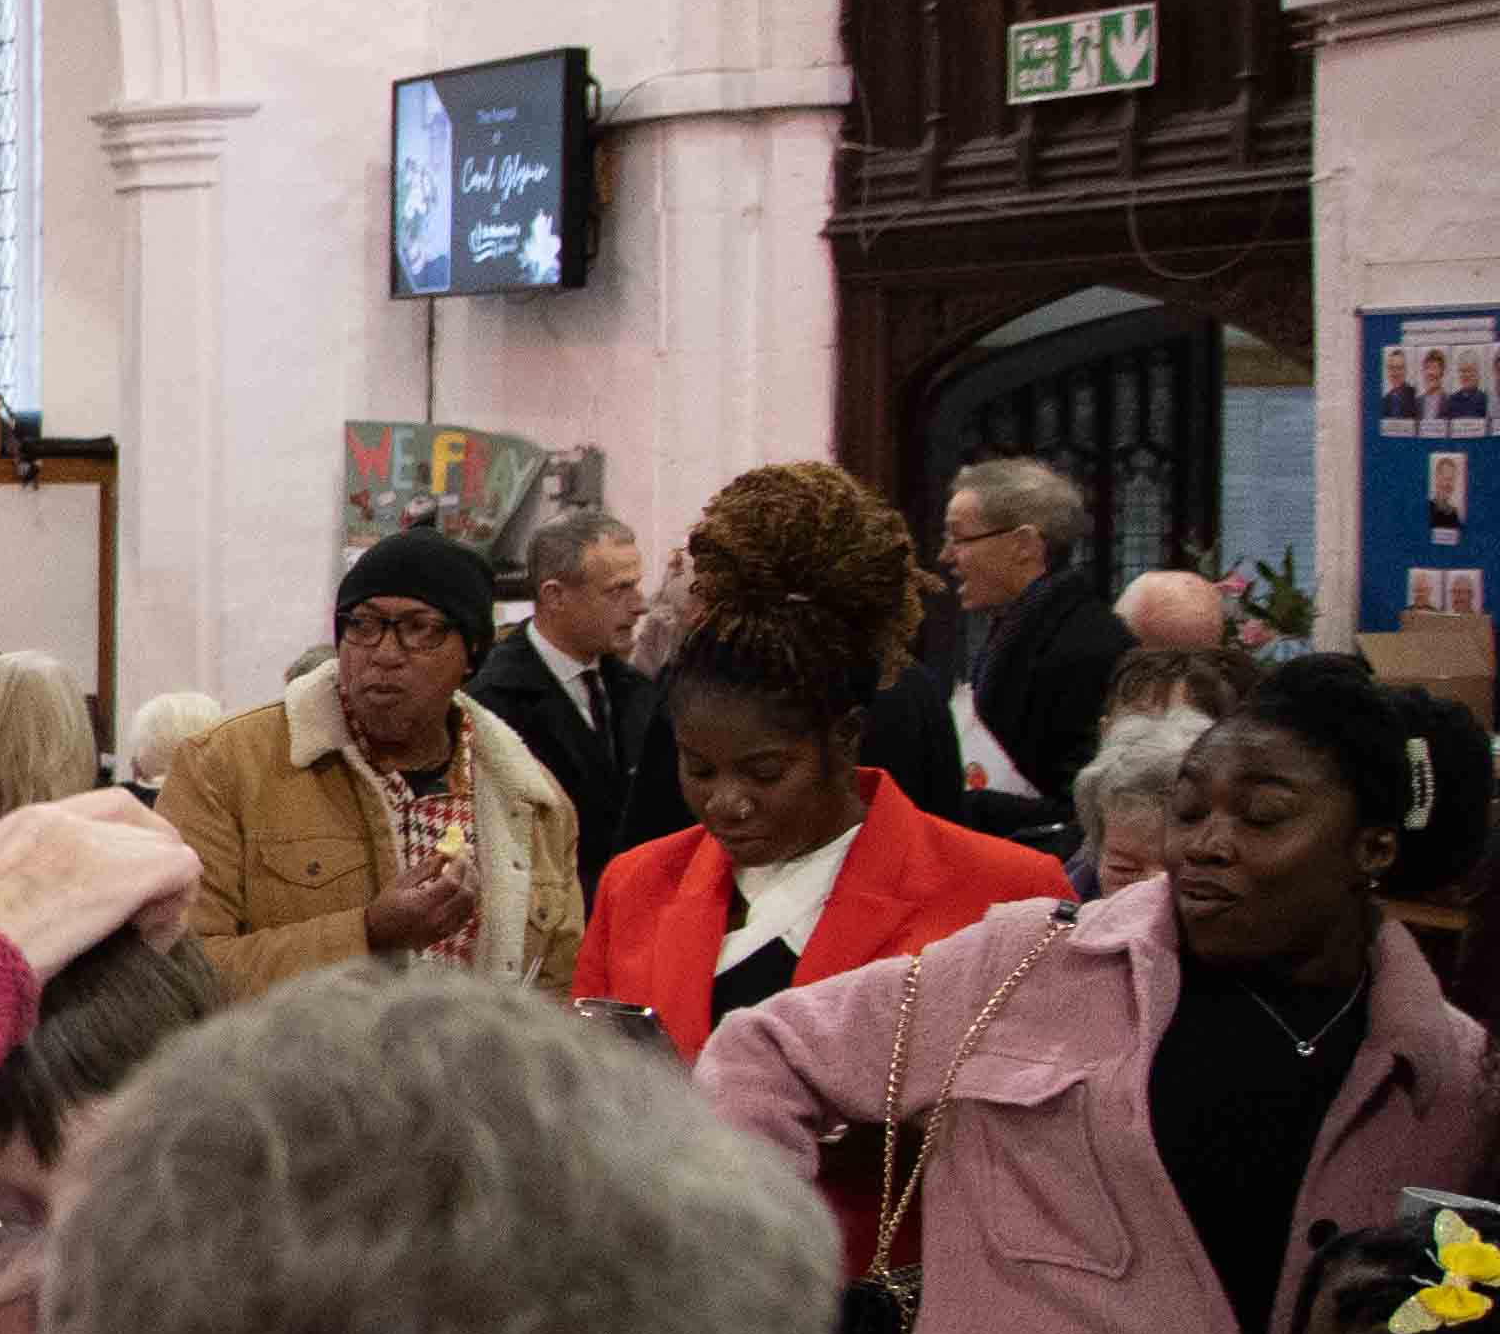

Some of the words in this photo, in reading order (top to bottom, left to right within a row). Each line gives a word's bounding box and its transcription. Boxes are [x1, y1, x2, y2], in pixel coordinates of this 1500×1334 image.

[1019, 33, 1058, 60] Fire
[1019, 60, 1055, 91] exit
[347, 425, 415, 492] WE
[430, 430, 546, 519] PRAY
